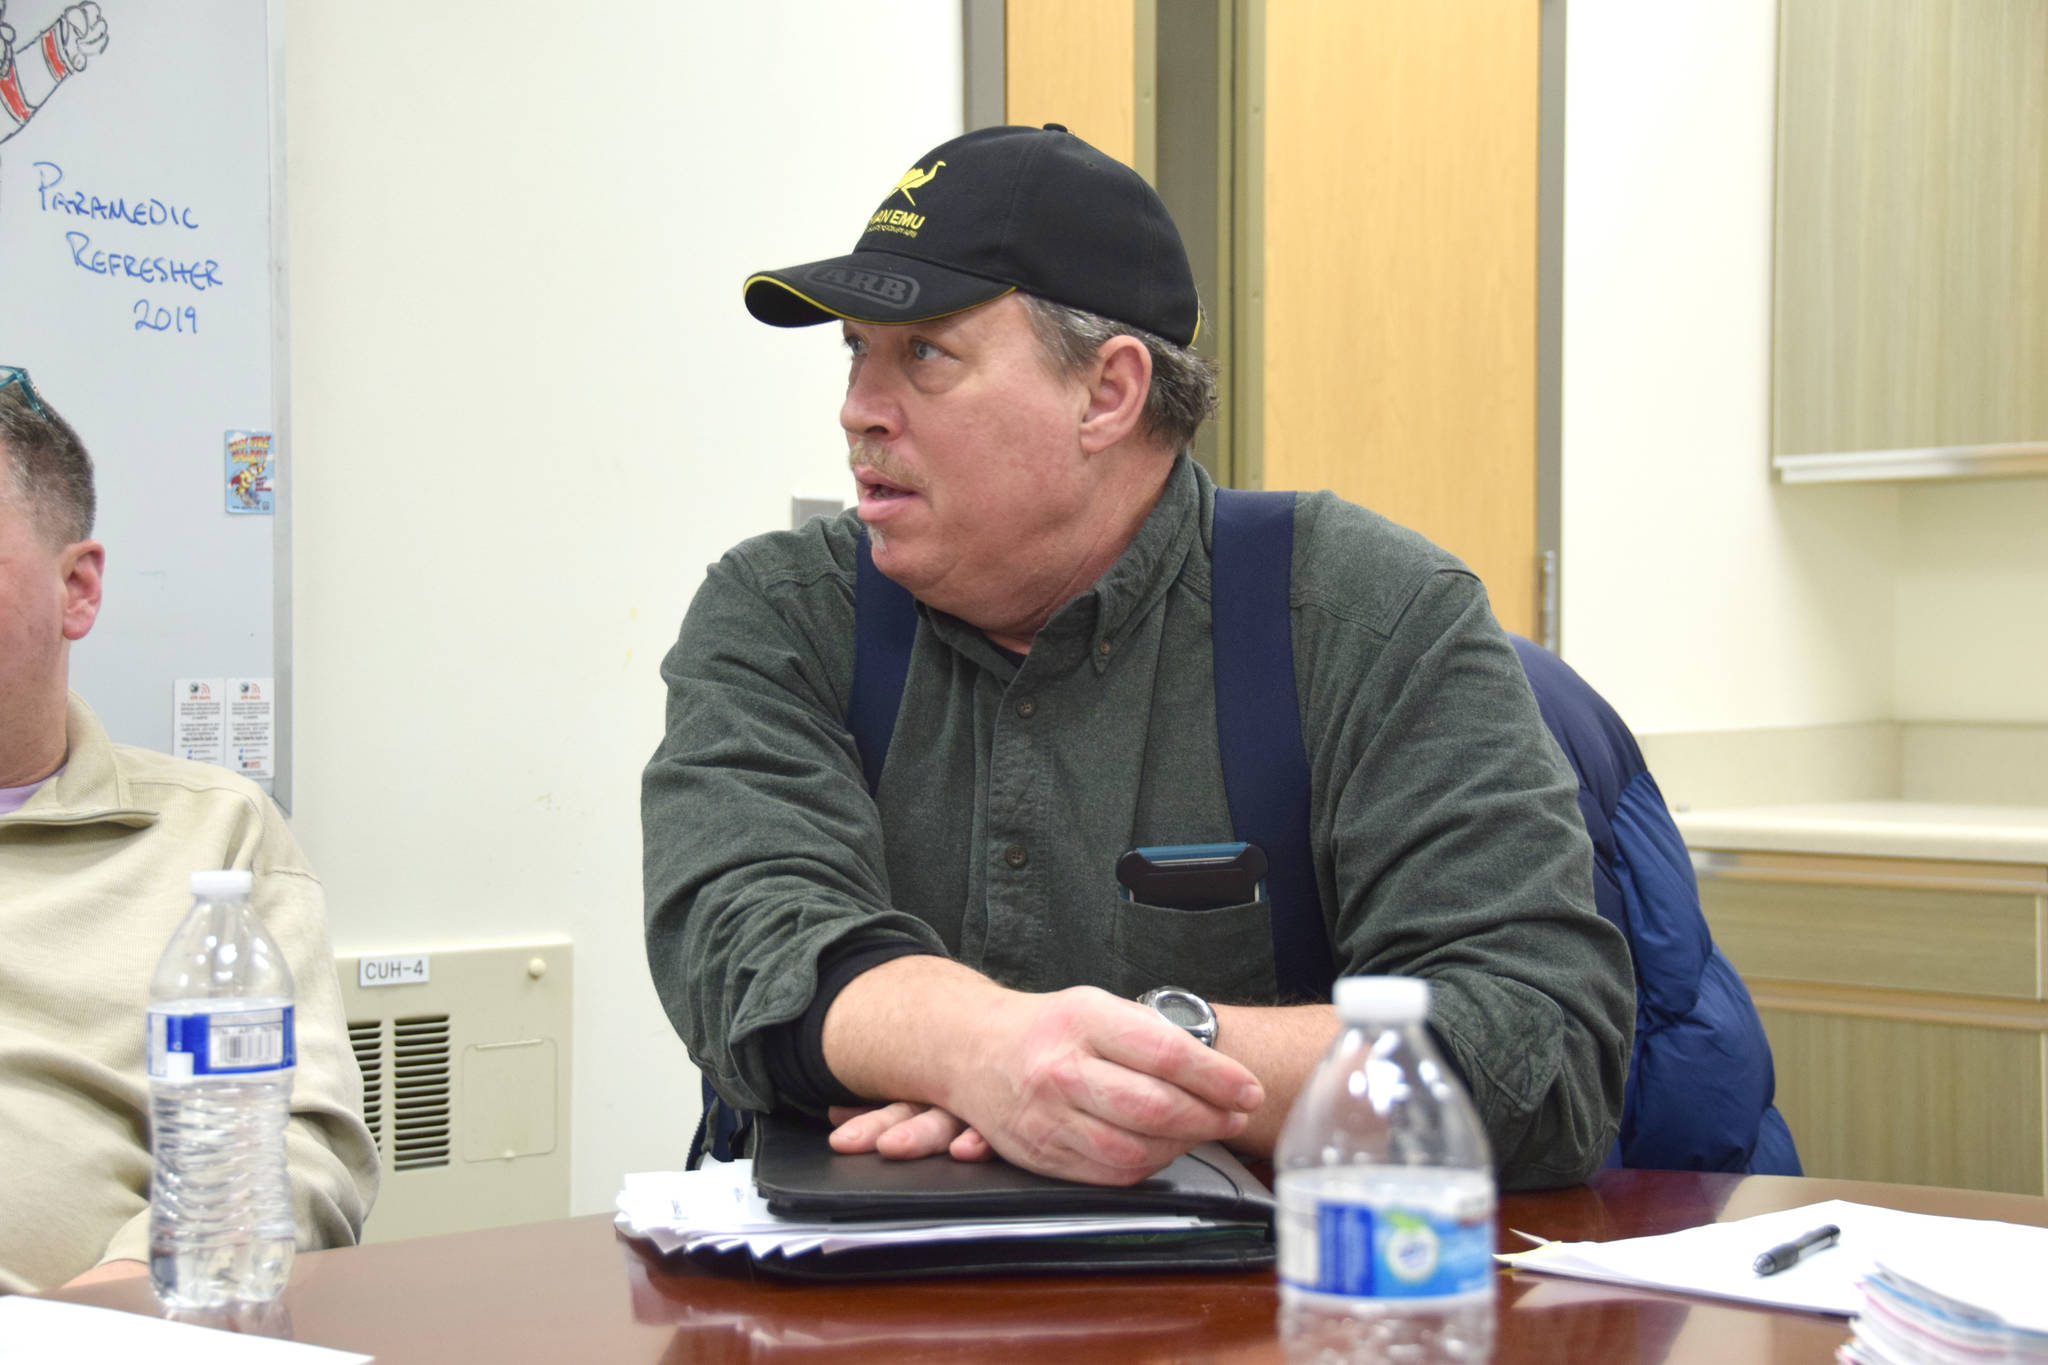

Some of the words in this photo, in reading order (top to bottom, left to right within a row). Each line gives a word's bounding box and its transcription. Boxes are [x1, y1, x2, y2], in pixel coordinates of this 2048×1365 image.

[33, 161, 199, 229] PARAMEDIC
[889, 209, 926, 230] EMU
[65, 231, 223, 290] REFRESHER
[815, 269, 907, 301] ARB
[133, 299, 198, 334] 2019
[365, 959, 424, 980] CUH-4
